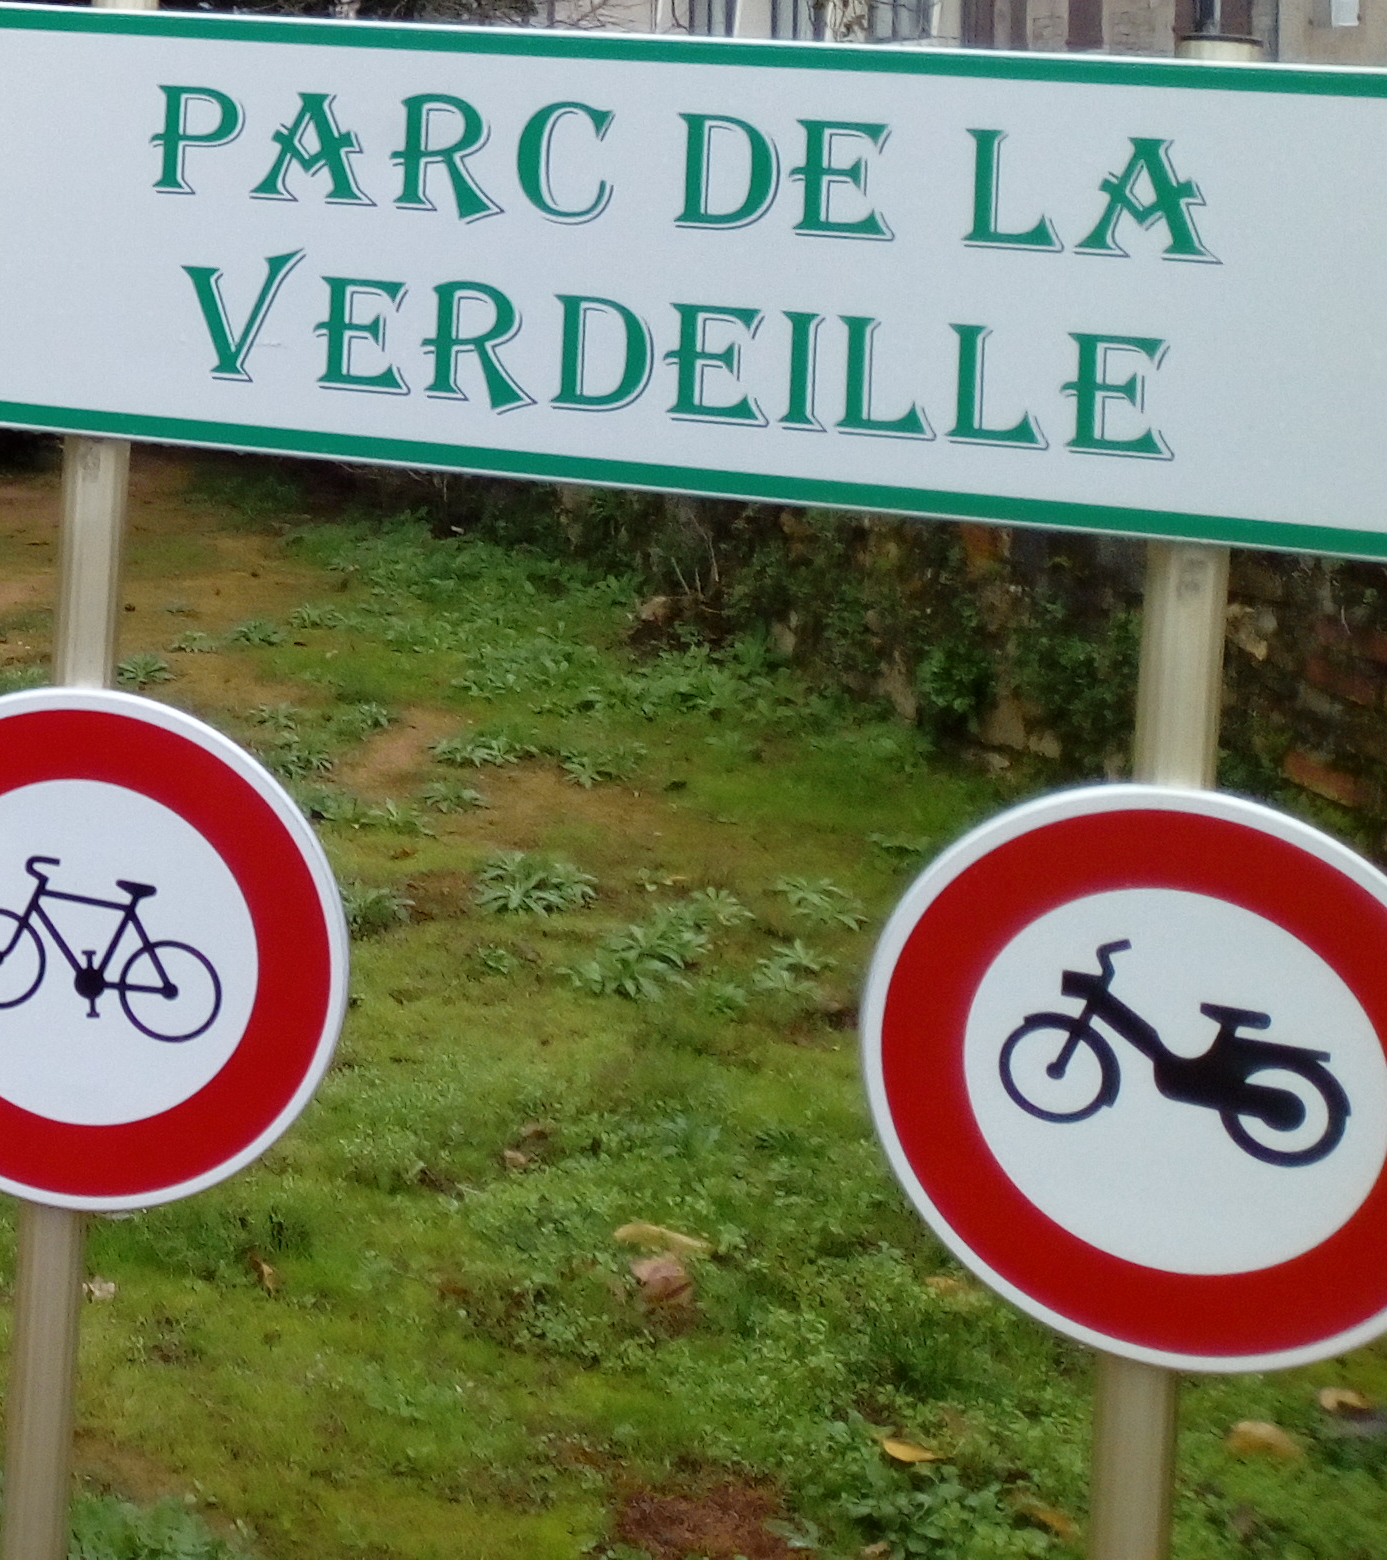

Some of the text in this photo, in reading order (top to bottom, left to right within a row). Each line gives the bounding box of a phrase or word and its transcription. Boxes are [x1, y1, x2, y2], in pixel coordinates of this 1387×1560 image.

[148, 83, 1223, 264] PARC DE LA
[180, 248, 1175, 461] VERDEILLE
